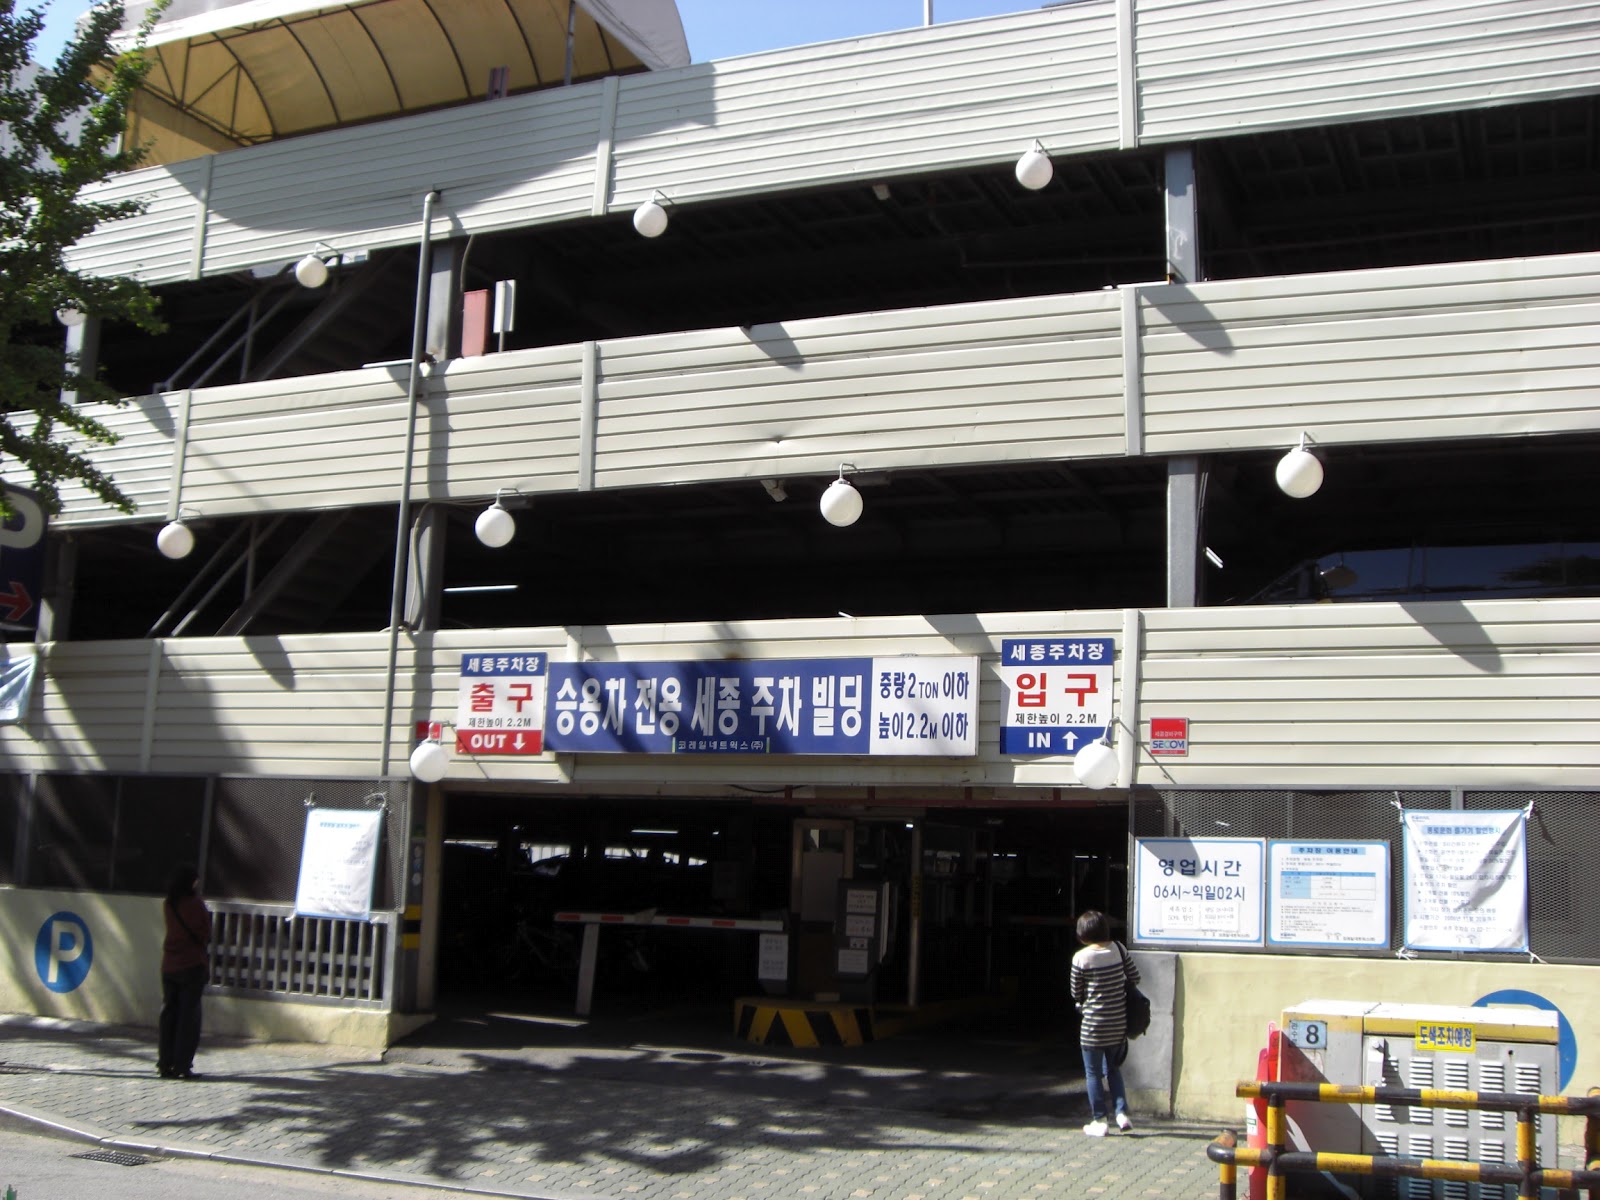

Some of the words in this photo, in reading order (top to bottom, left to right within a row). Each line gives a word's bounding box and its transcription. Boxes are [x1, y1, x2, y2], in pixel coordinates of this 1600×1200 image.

[1010, 644, 1104, 661] 세종주차장
[467, 656, 539, 673] 세종주차장
[943, 671, 969, 699] 이하
[555, 677, 626, 736] 승용차
[634, 677, 682, 737] 전용
[691, 676, 741, 736] 세종
[751, 675, 802, 737] 주차
[812, 674, 863, 738] 빌딩
[468, 717, 503, 728] 제한높이
[507, 717, 531, 728] 2.2M
[942, 711, 969, 741] 이하
[1015, 713, 1060, 725] 제한높이
[1066, 714, 1097, 724] 2.2M
[471, 735, 506, 749] OUT
[1028, 733, 1051, 749] IN
[1152, 740, 1185, 749] SECOM
[1158, 858, 1242, 877] 영업시간
[1153, 884, 1245, 901] 06시~익일02시
[48, 920, 85, 984] P
[1305, 1024, 1319, 1045] 8
